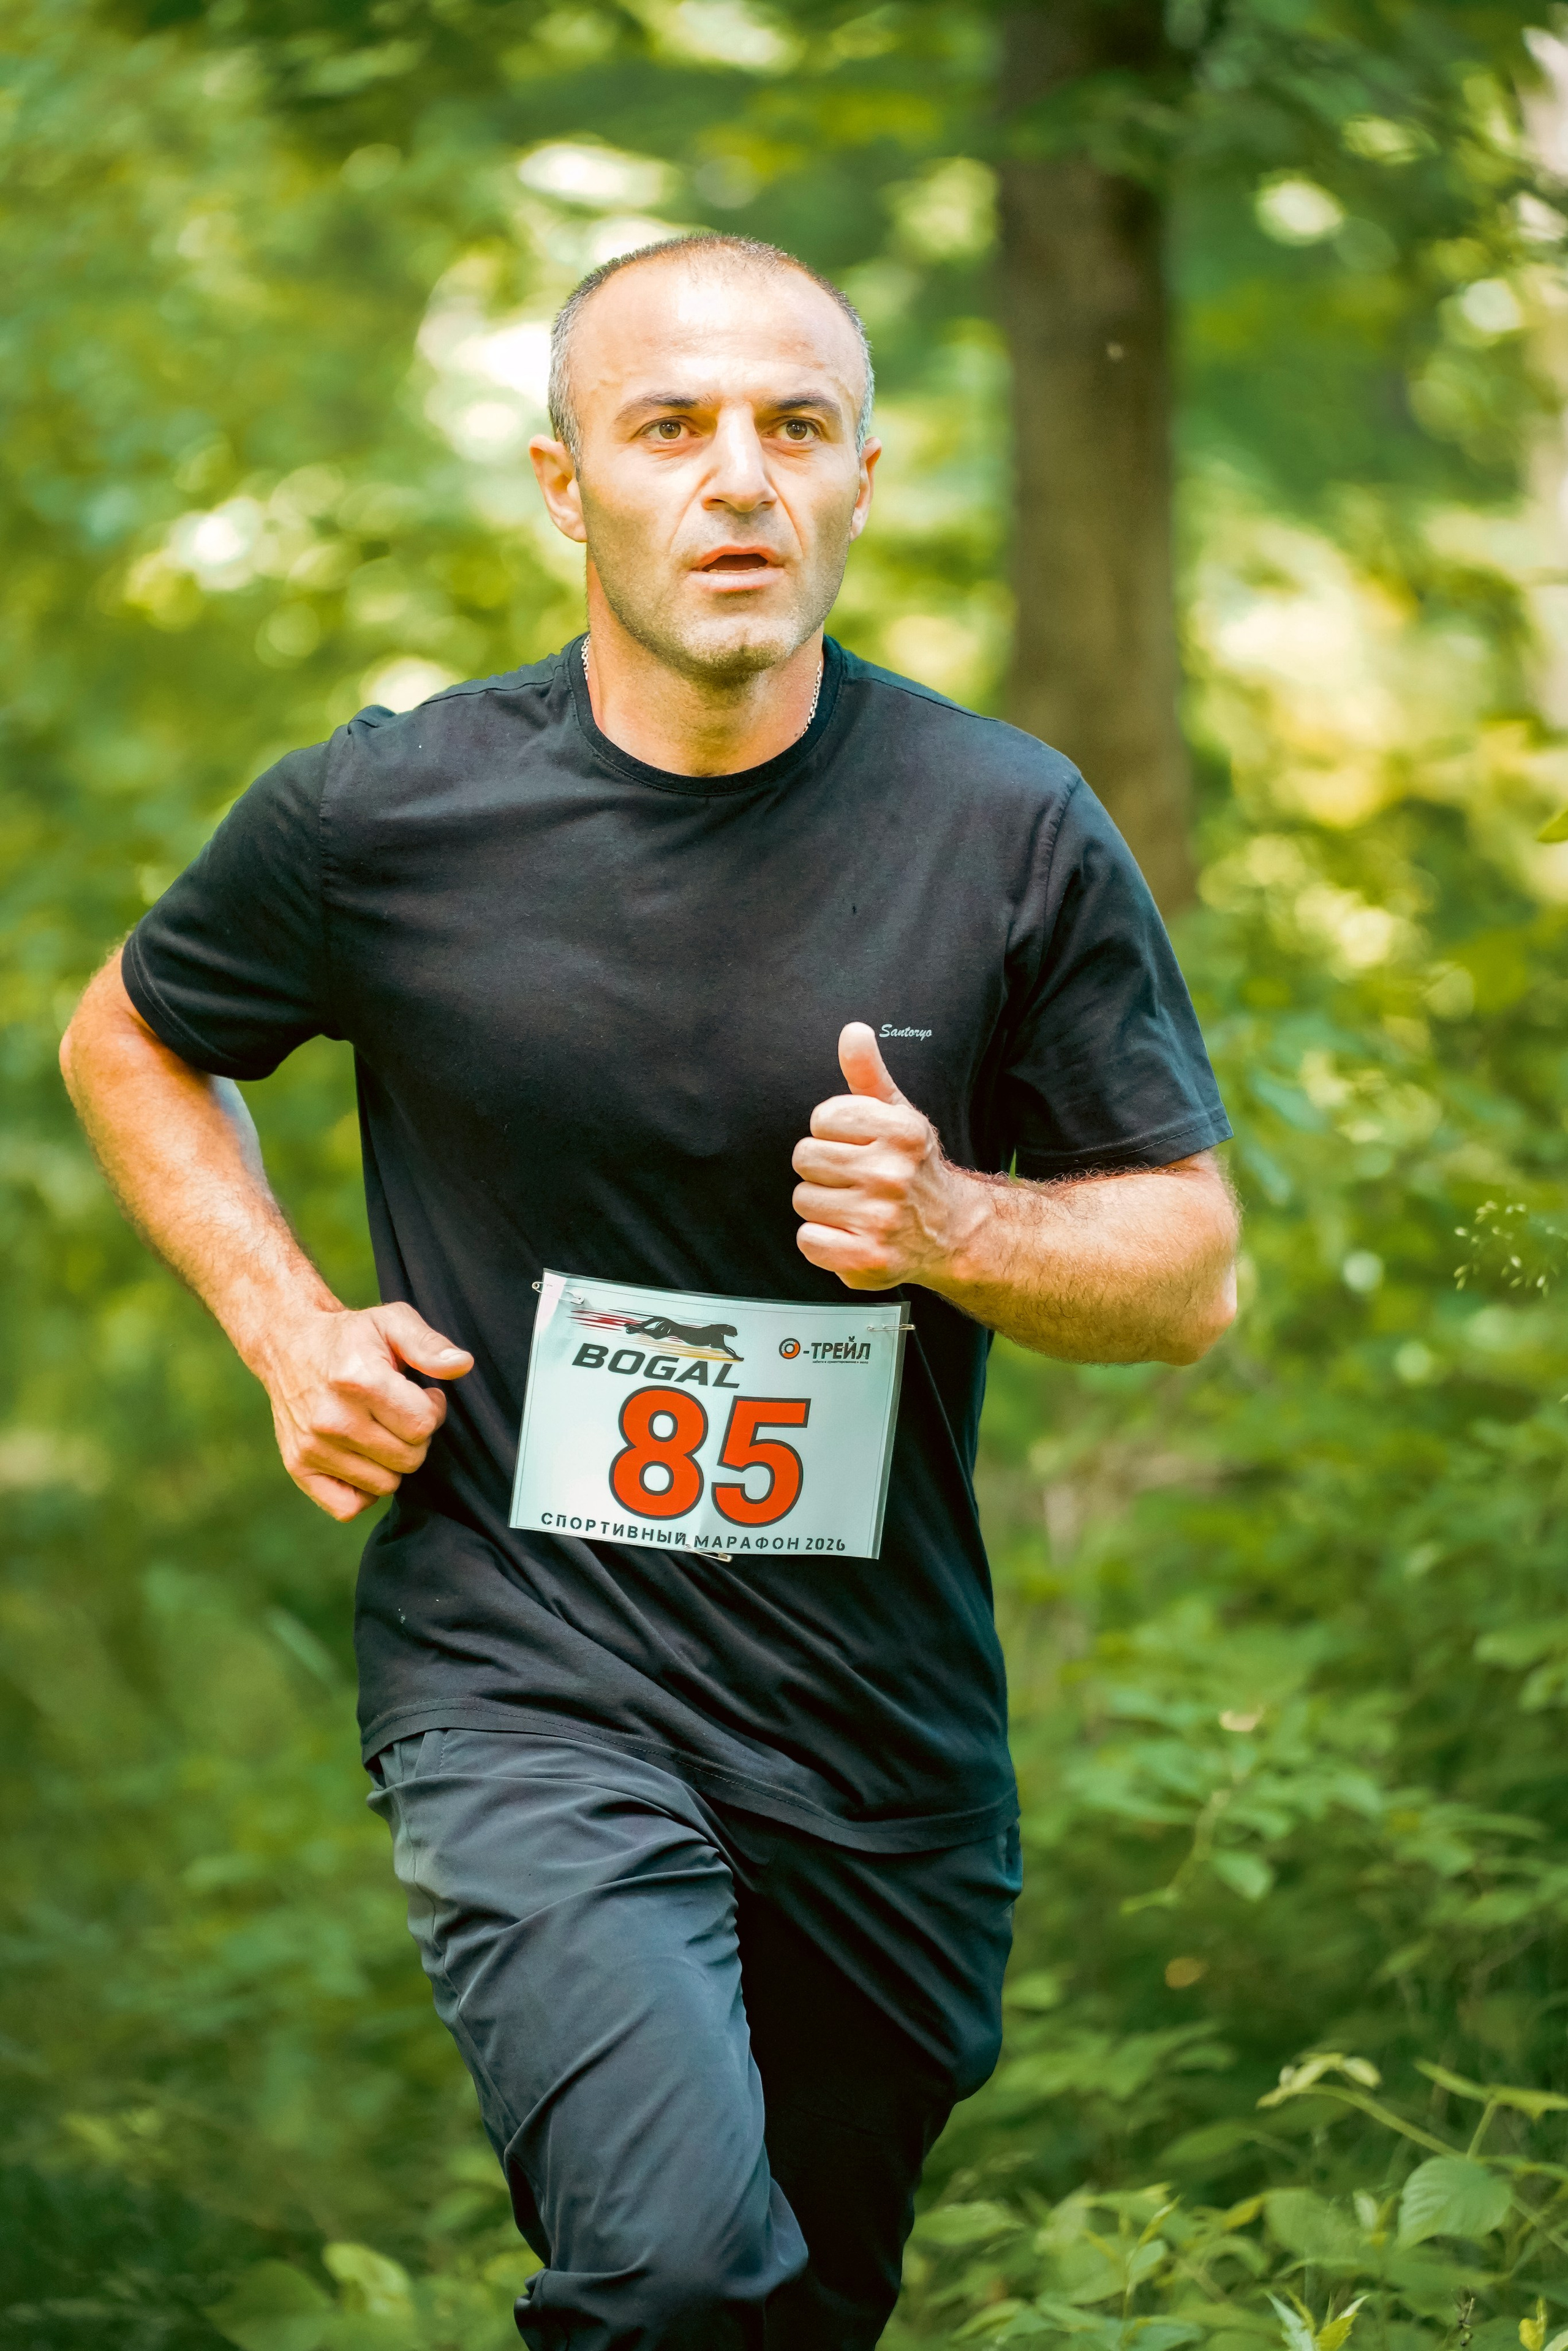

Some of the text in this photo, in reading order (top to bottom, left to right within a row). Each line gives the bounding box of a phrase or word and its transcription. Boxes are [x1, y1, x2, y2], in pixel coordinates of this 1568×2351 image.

[879, 1024, 932, 1041] Santoryo
[571, 1343, 740, 1389] BOGAL
[609, 1385, 811, 1528] 85
[541, 1512, 845, 1551] СПОРТИВНЫЙ МАРАФОН 2026
